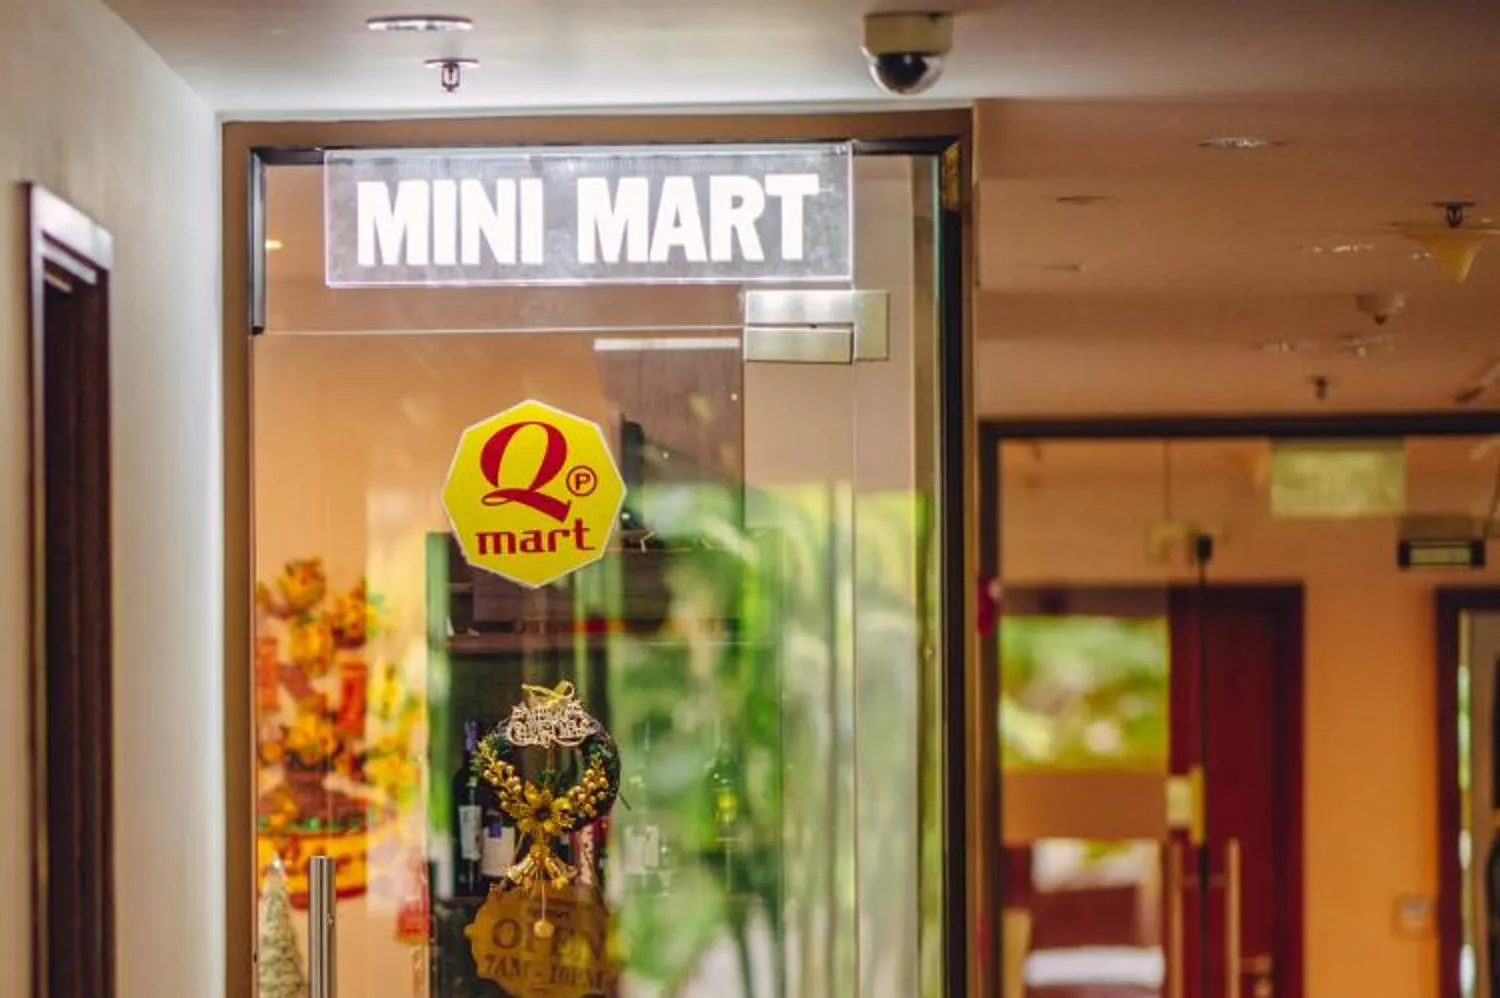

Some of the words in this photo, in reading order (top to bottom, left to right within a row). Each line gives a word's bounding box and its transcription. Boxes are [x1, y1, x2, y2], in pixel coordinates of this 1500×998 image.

[357, 178, 544, 267] MINI
[576, 173, 820, 264] MART
[479, 421, 571, 523] Q
[475, 518, 596, 556] mart
